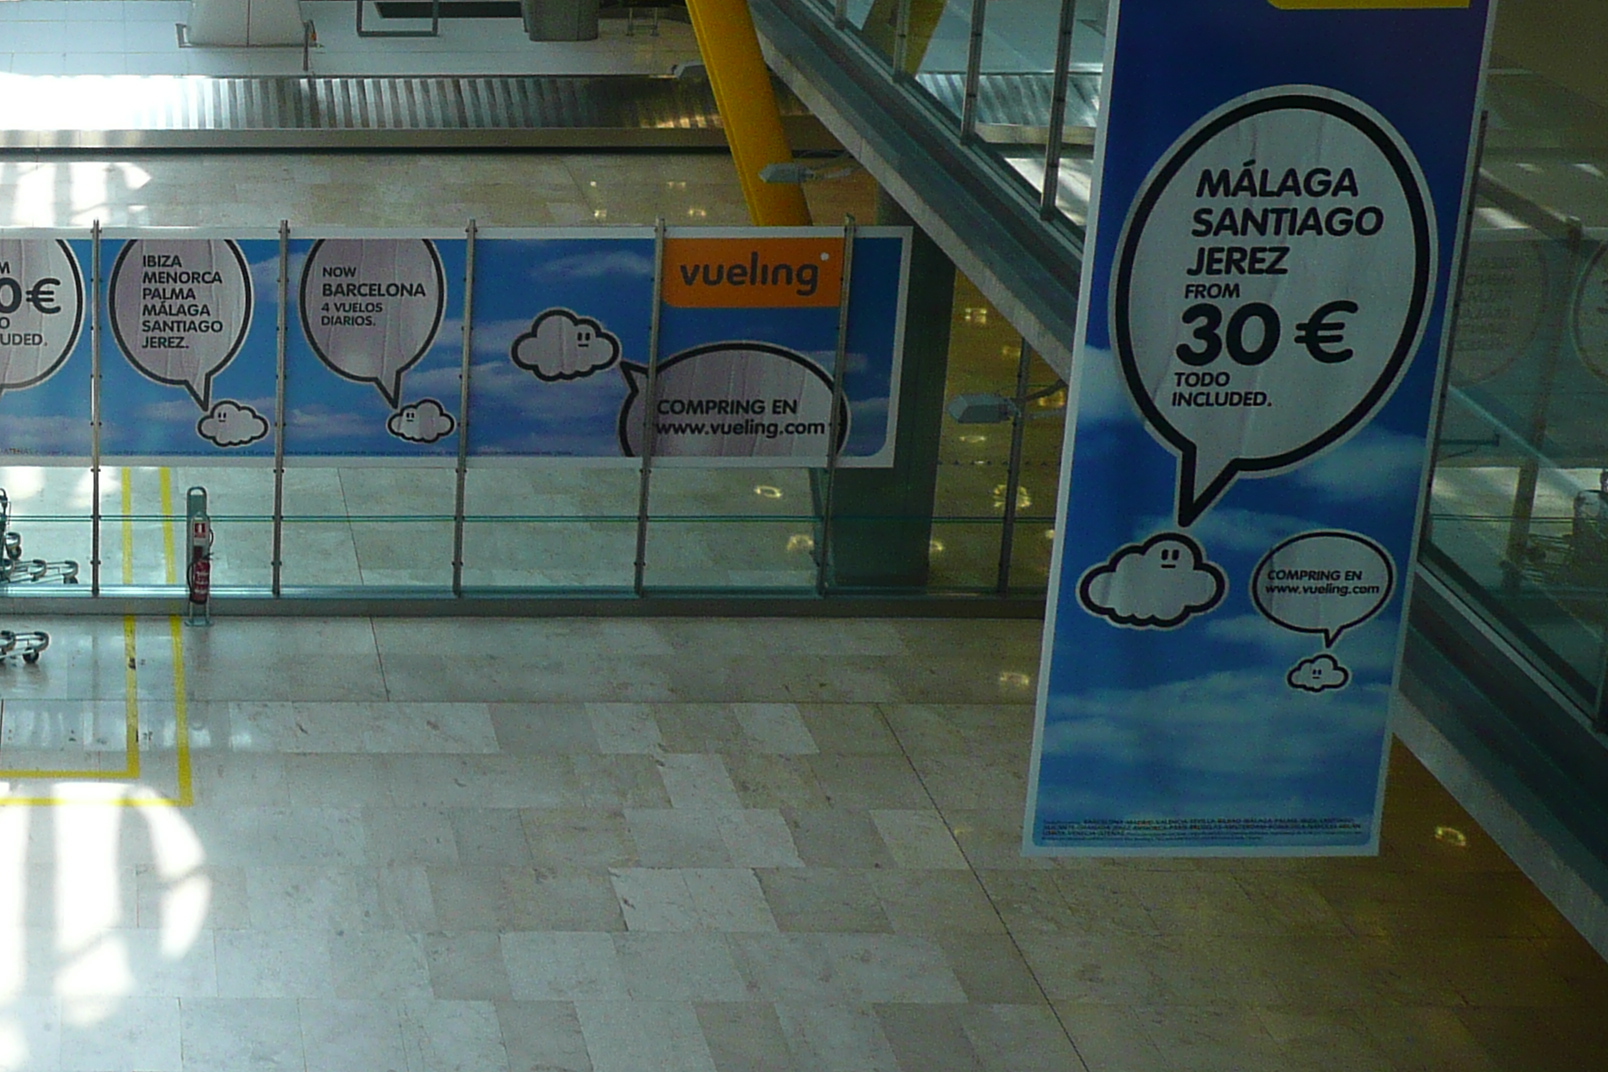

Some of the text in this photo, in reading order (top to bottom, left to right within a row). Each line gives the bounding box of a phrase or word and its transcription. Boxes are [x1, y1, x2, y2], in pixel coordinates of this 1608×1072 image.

[1195, 158, 1359, 198] MÁLAGA
[1191, 207, 1384, 237] SANTIAGO
[143, 255, 181, 268] IBIZA
[1186, 246, 1291, 276] JEREZ
[143, 271, 222, 284] MENORCA
[322, 266, 356, 278] NOW
[680, 252, 819, 296] vueling
[143, 288, 196, 300] PALMA
[322, 283, 425, 298] BARCELONA
[1185, 283, 1240, 299] FROM
[142, 300, 211, 317] MÁLAGA
[322, 303, 383, 313] 4 VUELOS
[142, 320, 223, 333] SANTIAGO
[321, 315, 376, 326] DIARIOS.
[142, 336, 189, 349] JEREZ.
[1174, 372, 1231, 387] TODO
[657, 399, 797, 415] COMPRING EN
[1172, 392, 1272, 407] INCLUDED.
[656, 420, 825, 438] www.vueling.com
[1267, 569, 1363, 582] COMPRING EN
[1265, 582, 1380, 597] www.vueling.com
